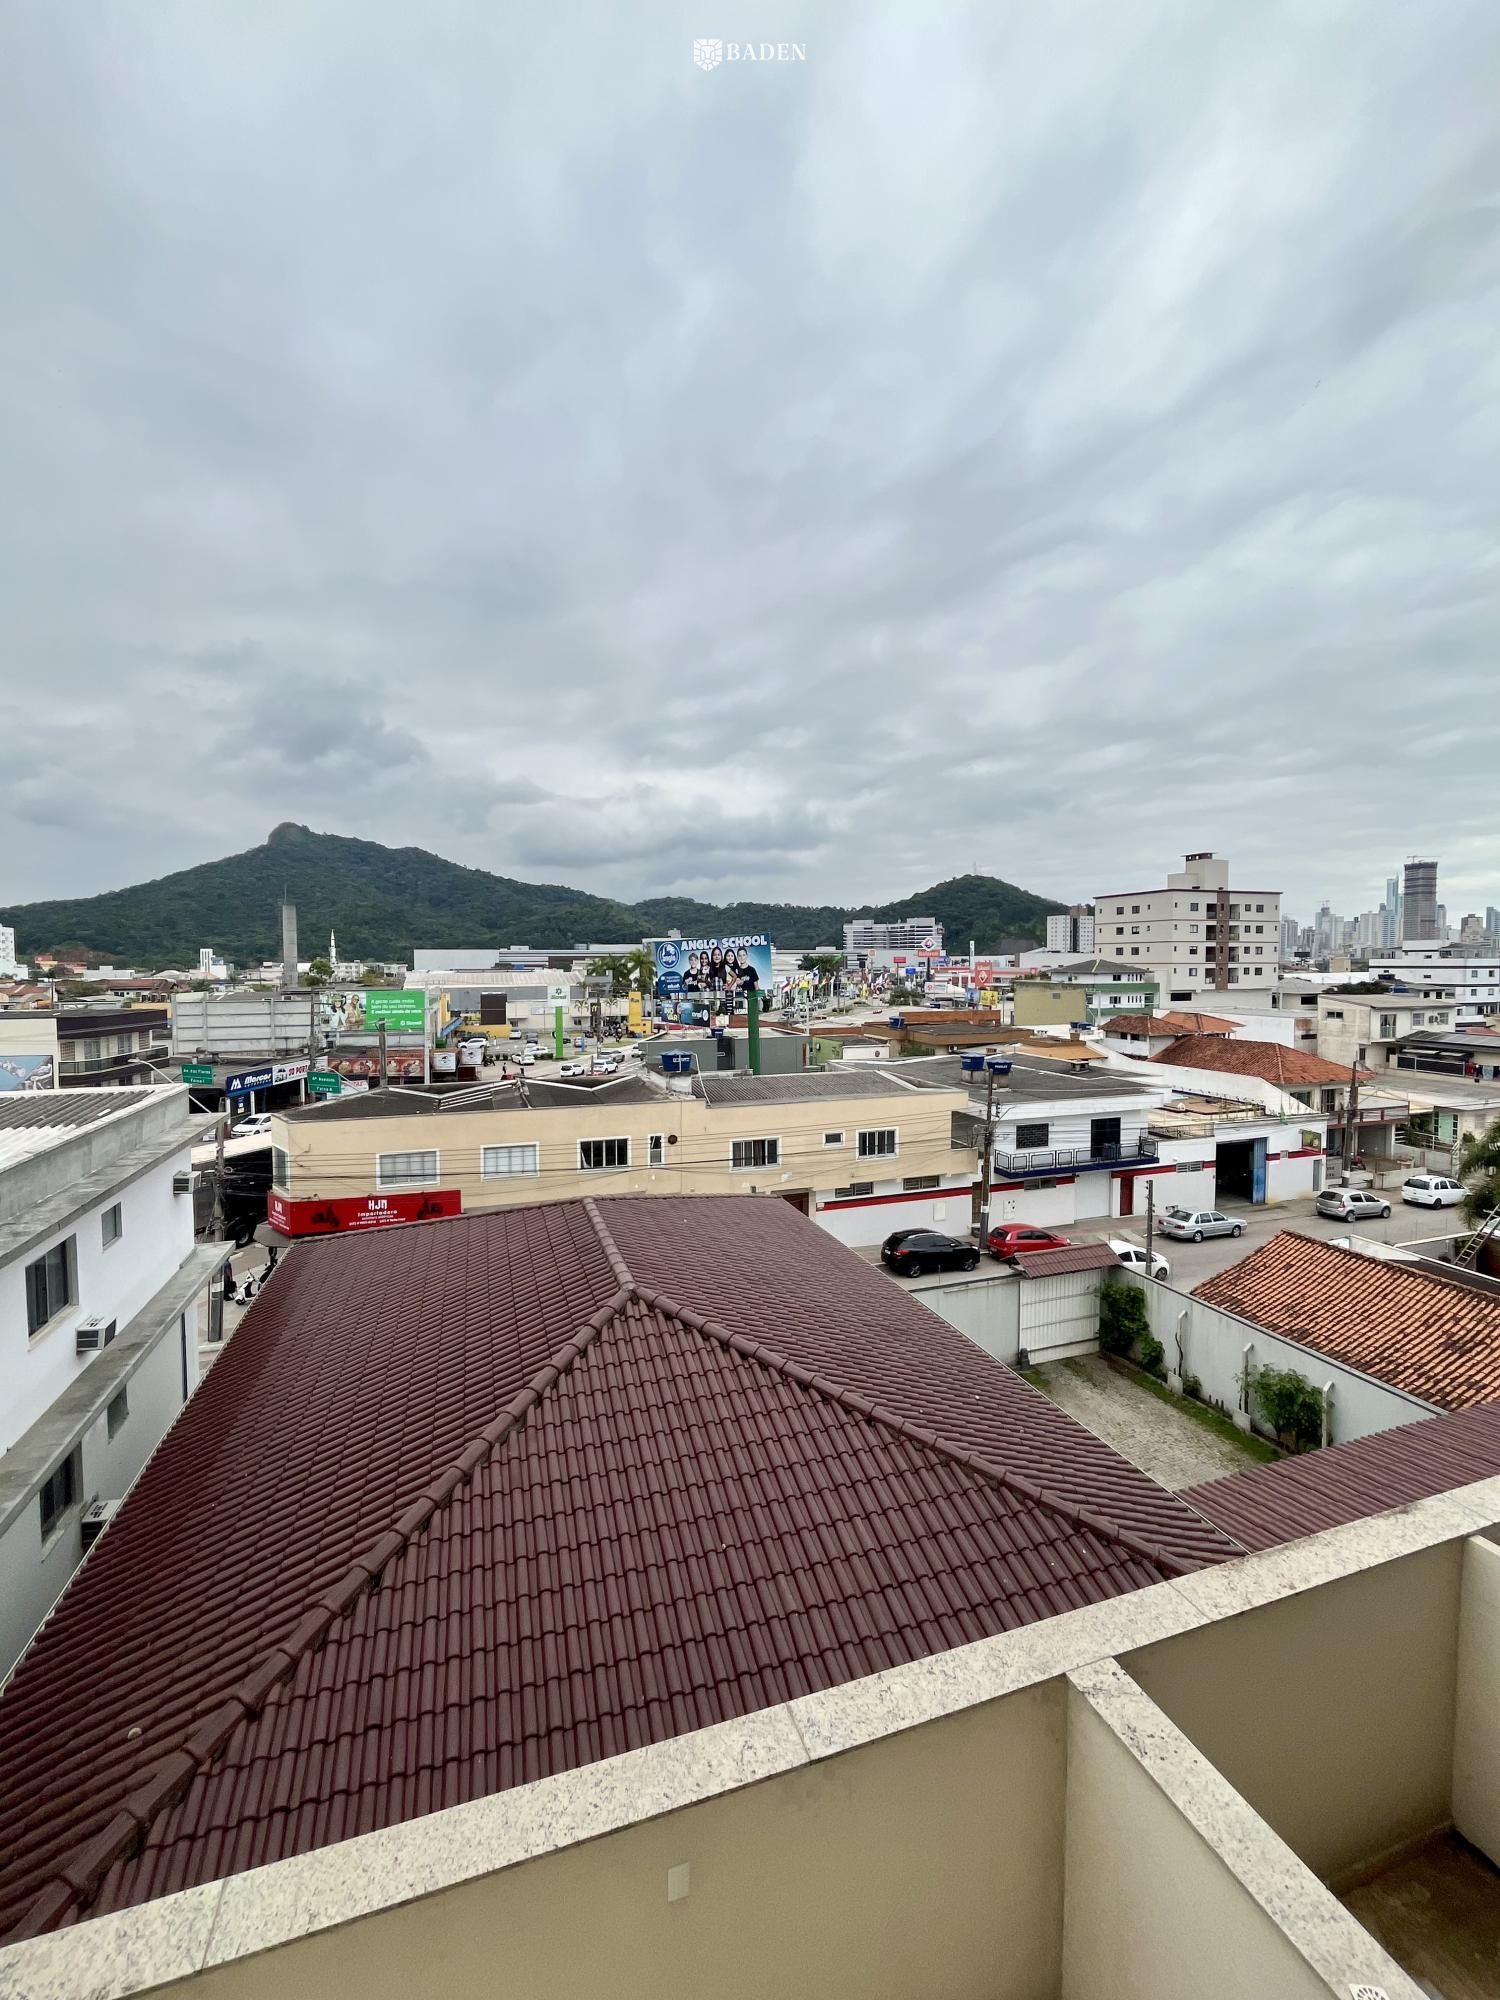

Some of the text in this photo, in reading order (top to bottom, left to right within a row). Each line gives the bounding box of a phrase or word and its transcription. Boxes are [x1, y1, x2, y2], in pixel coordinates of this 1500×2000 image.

[681, 935, 768, 951] ANGLO SCHOOL
[244, 1073, 272, 1085] Marcos
